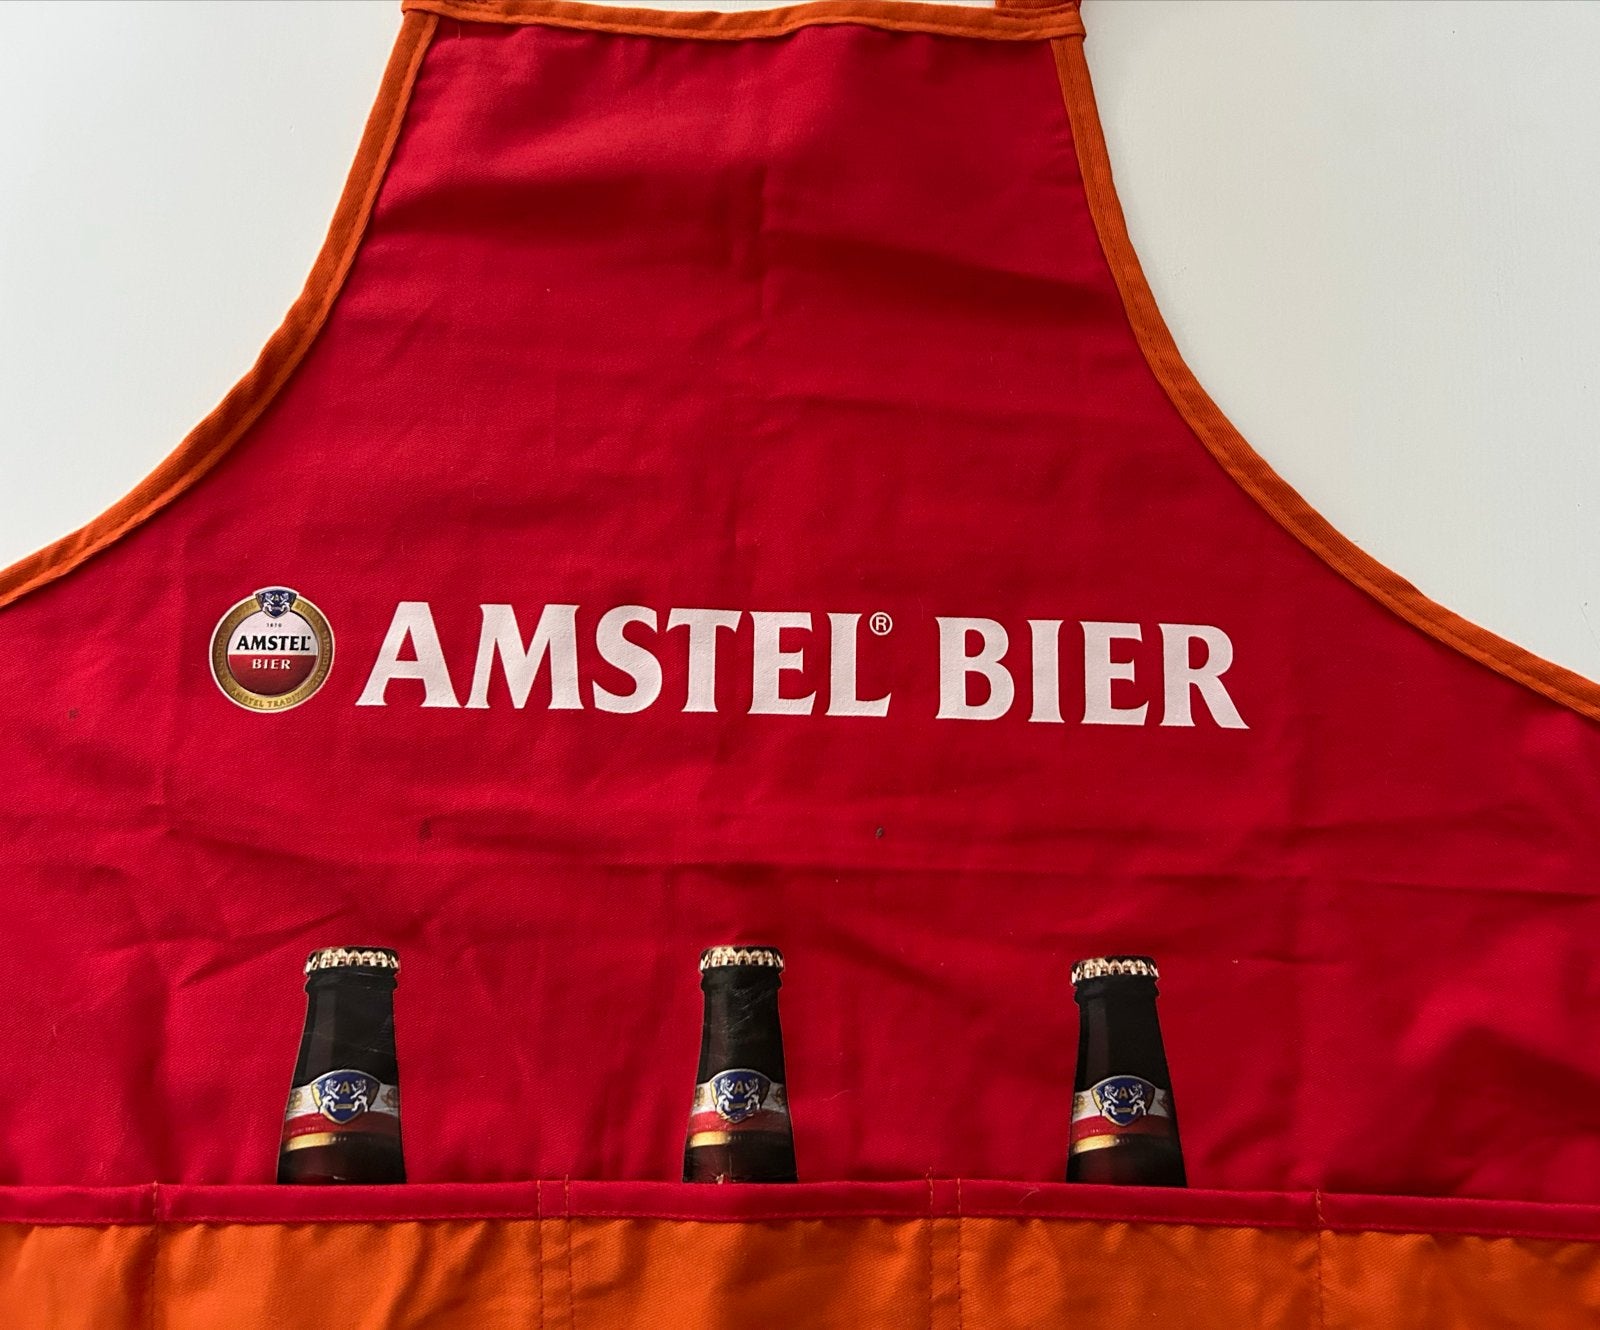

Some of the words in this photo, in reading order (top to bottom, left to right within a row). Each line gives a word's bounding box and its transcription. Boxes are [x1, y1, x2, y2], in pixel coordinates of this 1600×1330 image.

[236, 635, 311, 651] AMSTEL
[252, 658, 291, 670] BIER
[935, 616, 1250, 729] BIER
[231, 687, 264, 707] AMSTEL
[340, 1082, 351, 1094] A
[734, 1080, 744, 1093] A
[1119, 1086, 1129, 1099] A
